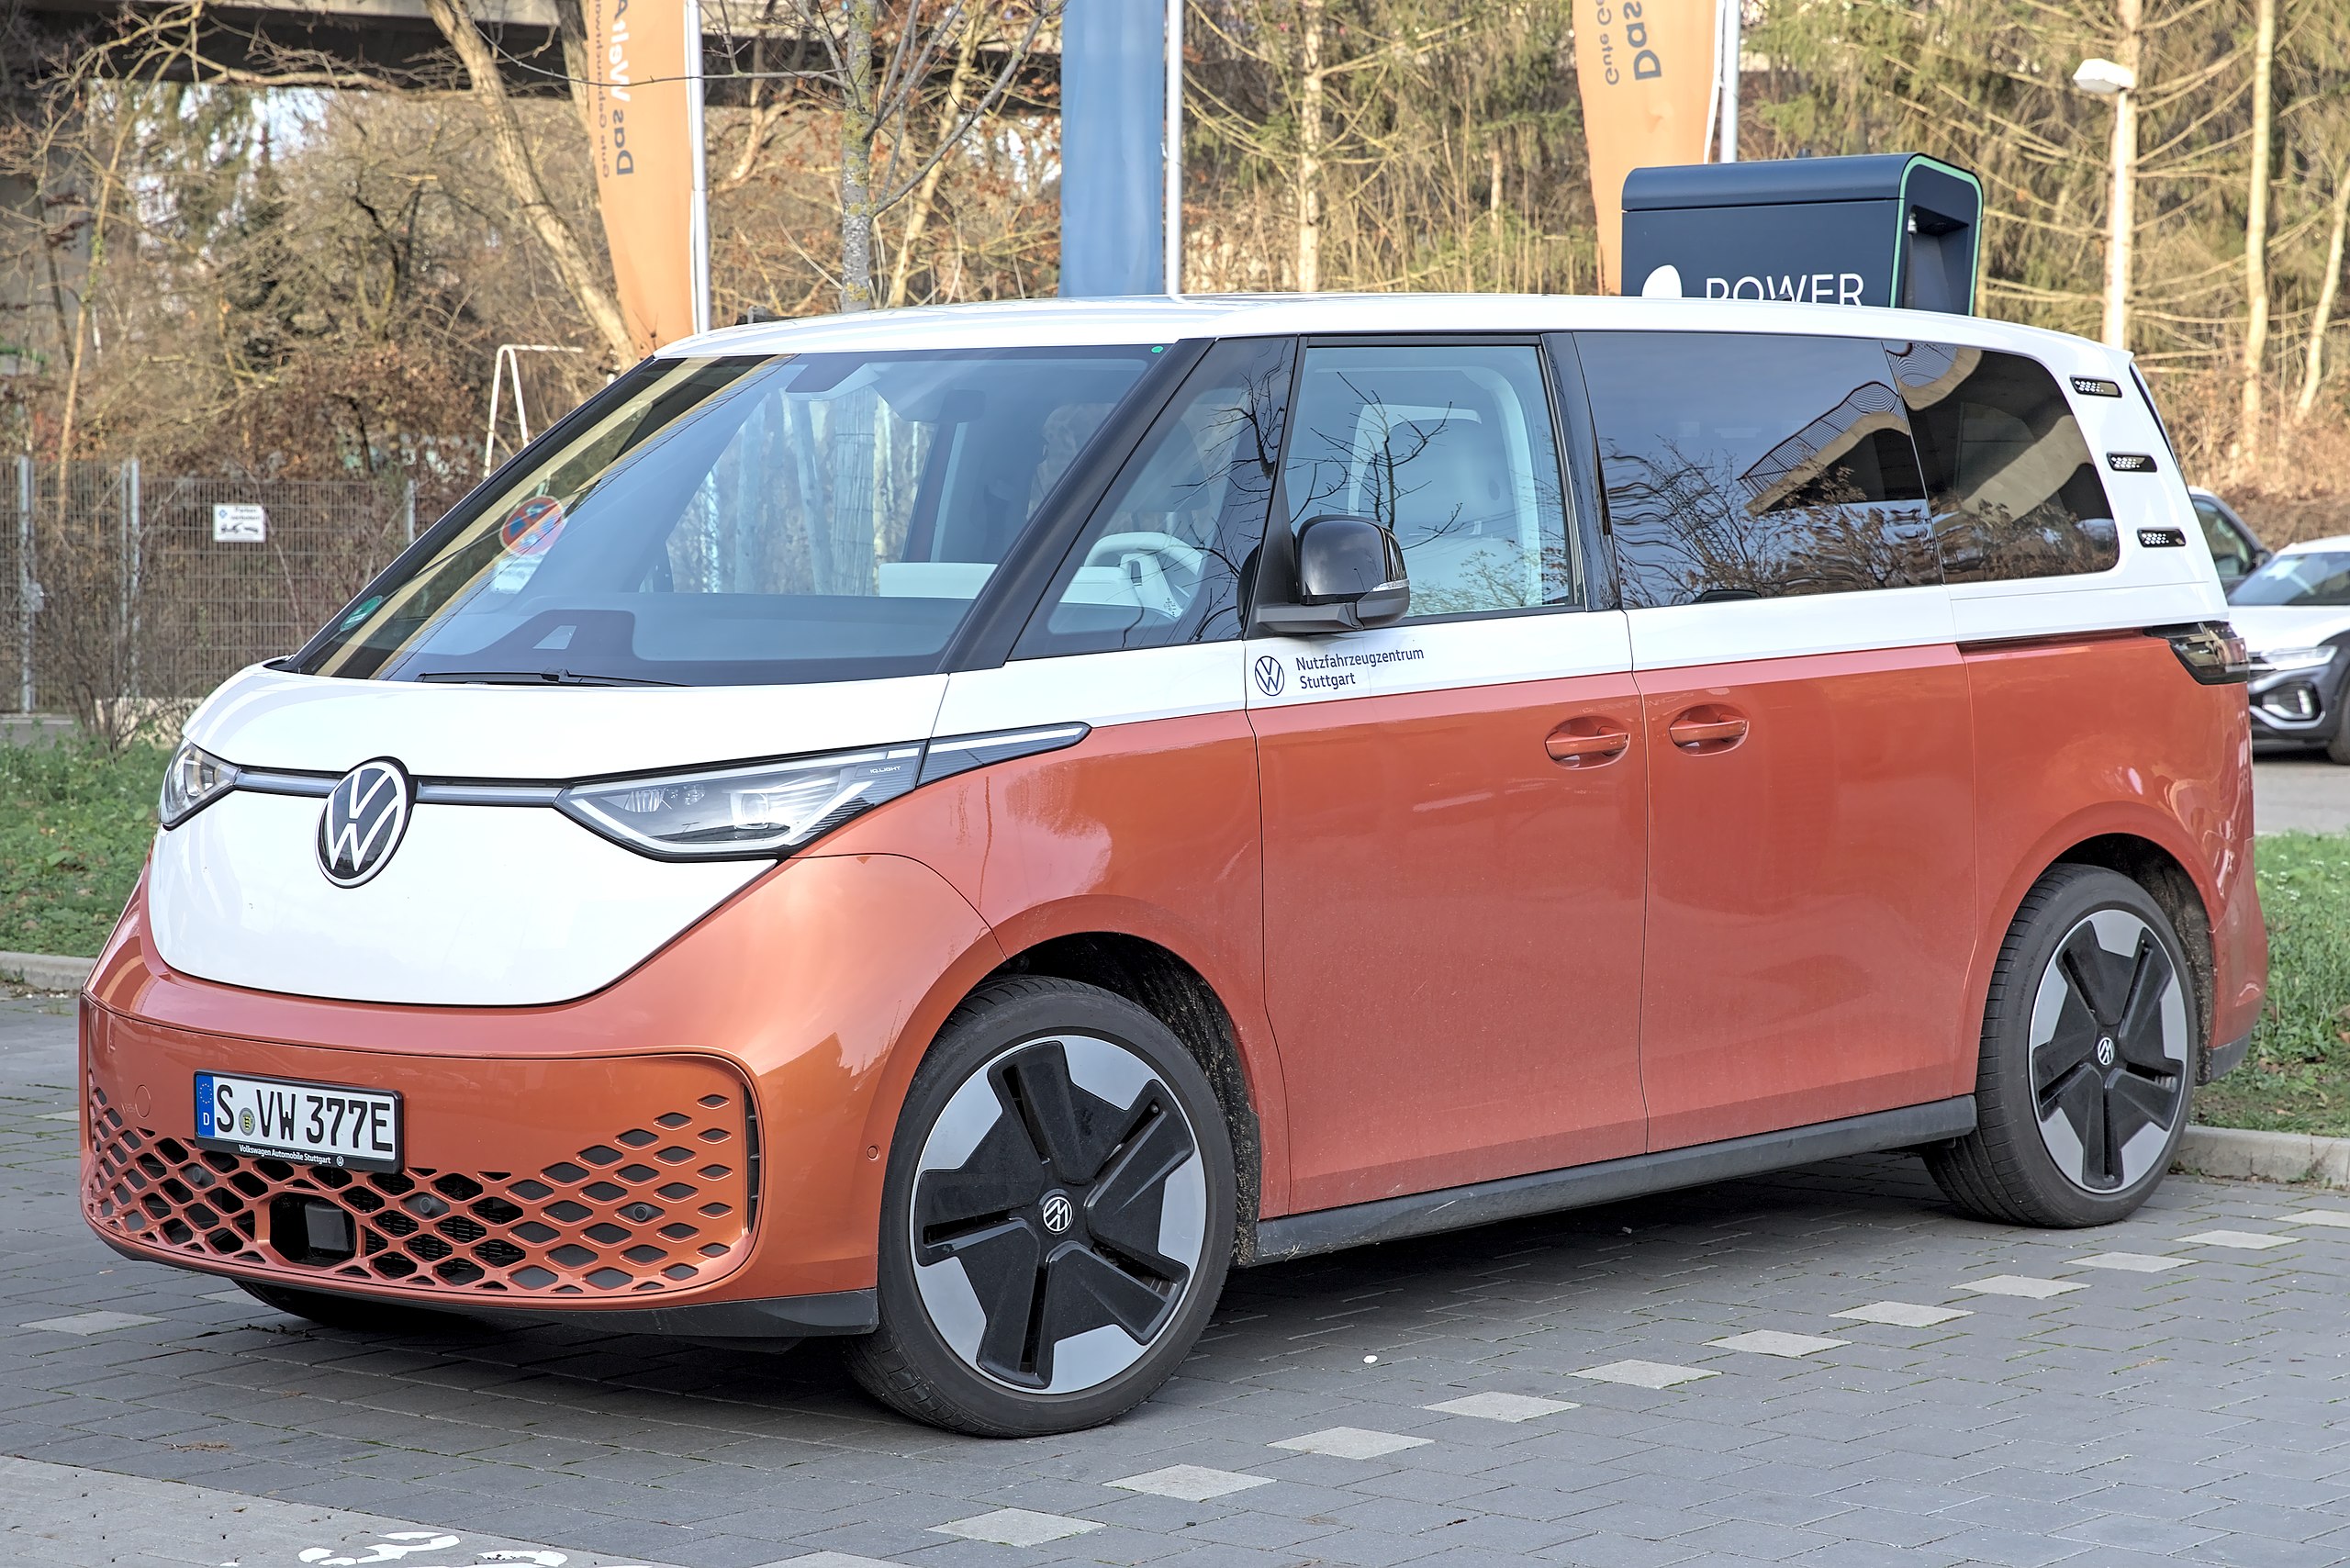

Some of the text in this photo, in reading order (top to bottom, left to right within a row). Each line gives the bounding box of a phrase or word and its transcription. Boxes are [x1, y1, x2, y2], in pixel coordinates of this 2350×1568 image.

[1706, 273, 1864, 306] POWER
[1295, 648, 1425, 672] Nutzfahrzeugzentrum
[1299, 672, 1357, 690] Stuttgart
[202, 1112, 210, 1126] D
[216, 1084, 393, 1152] S VW 377E
[239, 1144, 331, 1165] Volkswagen Automobile Stuttgart
